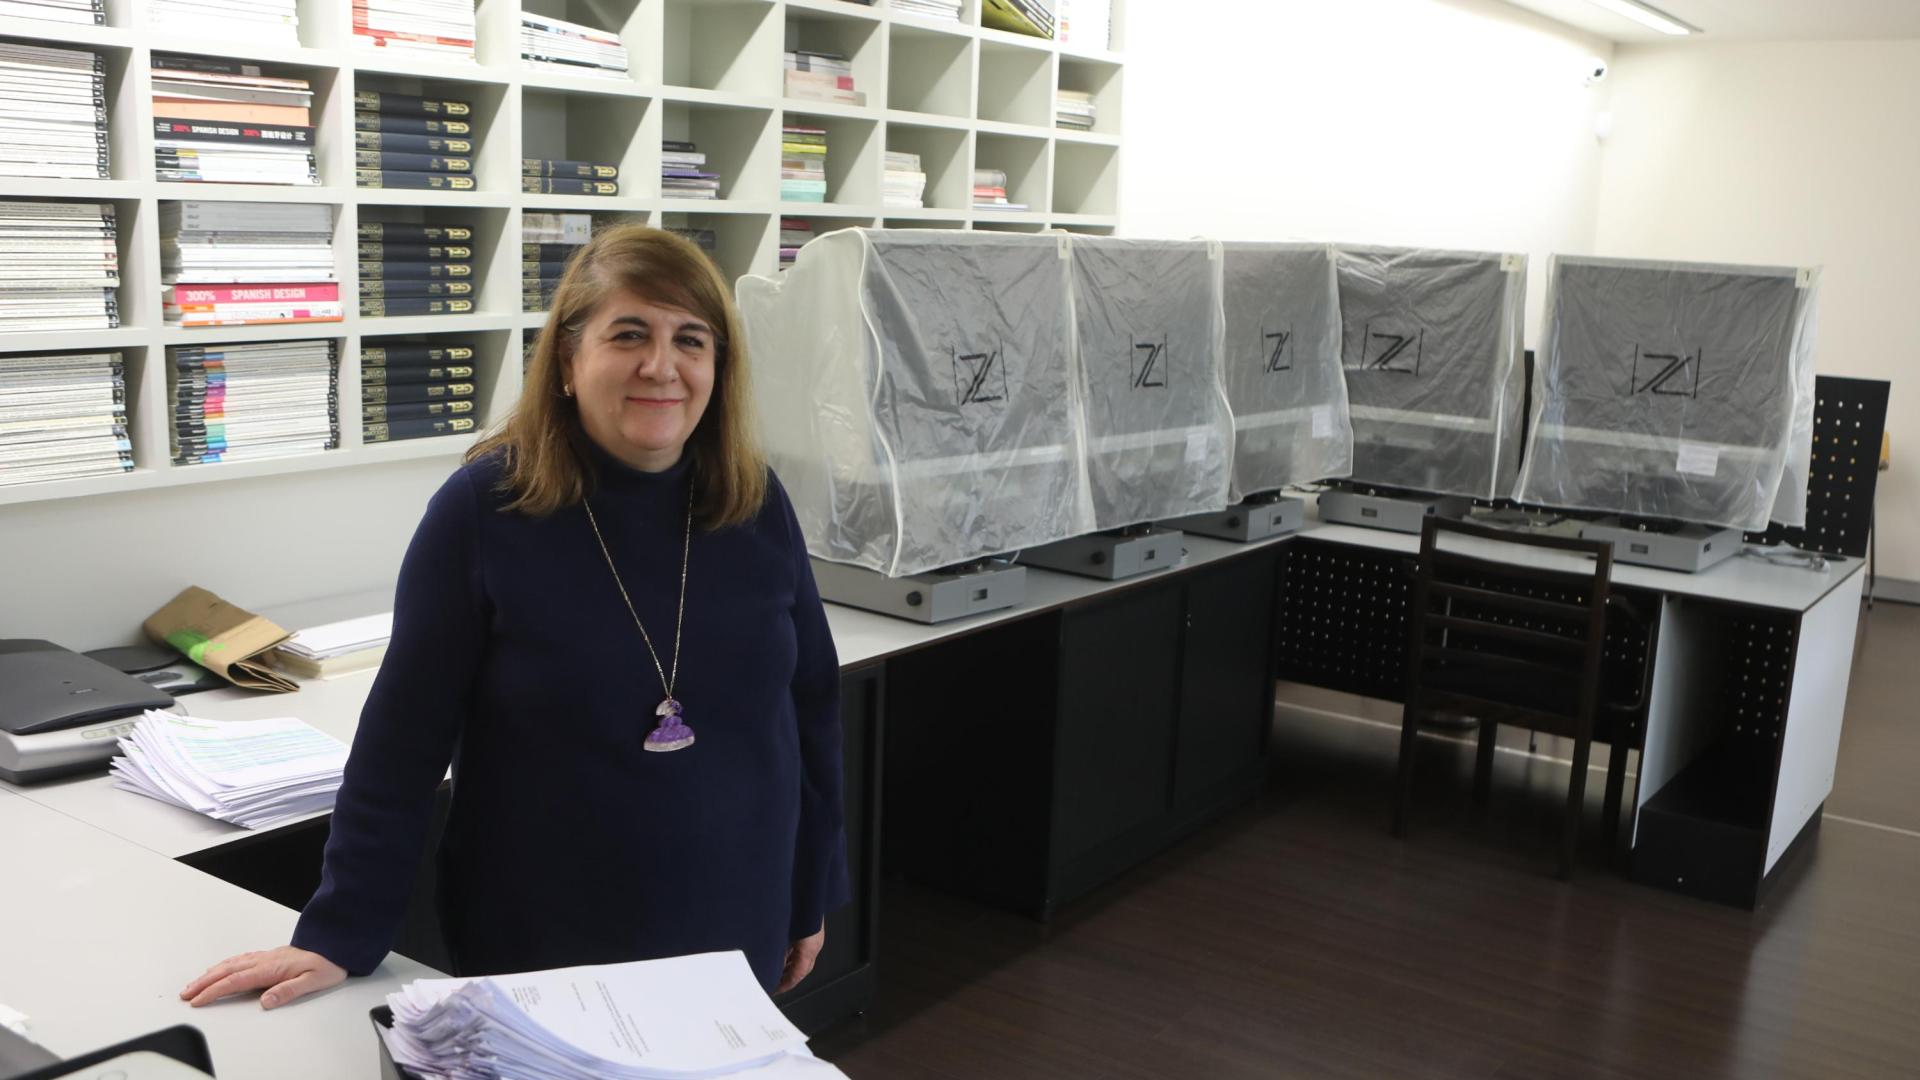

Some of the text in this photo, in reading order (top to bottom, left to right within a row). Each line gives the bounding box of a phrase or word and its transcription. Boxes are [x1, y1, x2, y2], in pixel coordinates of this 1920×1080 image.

[185, 288, 306, 302] 300% SPANISH DESIGN
